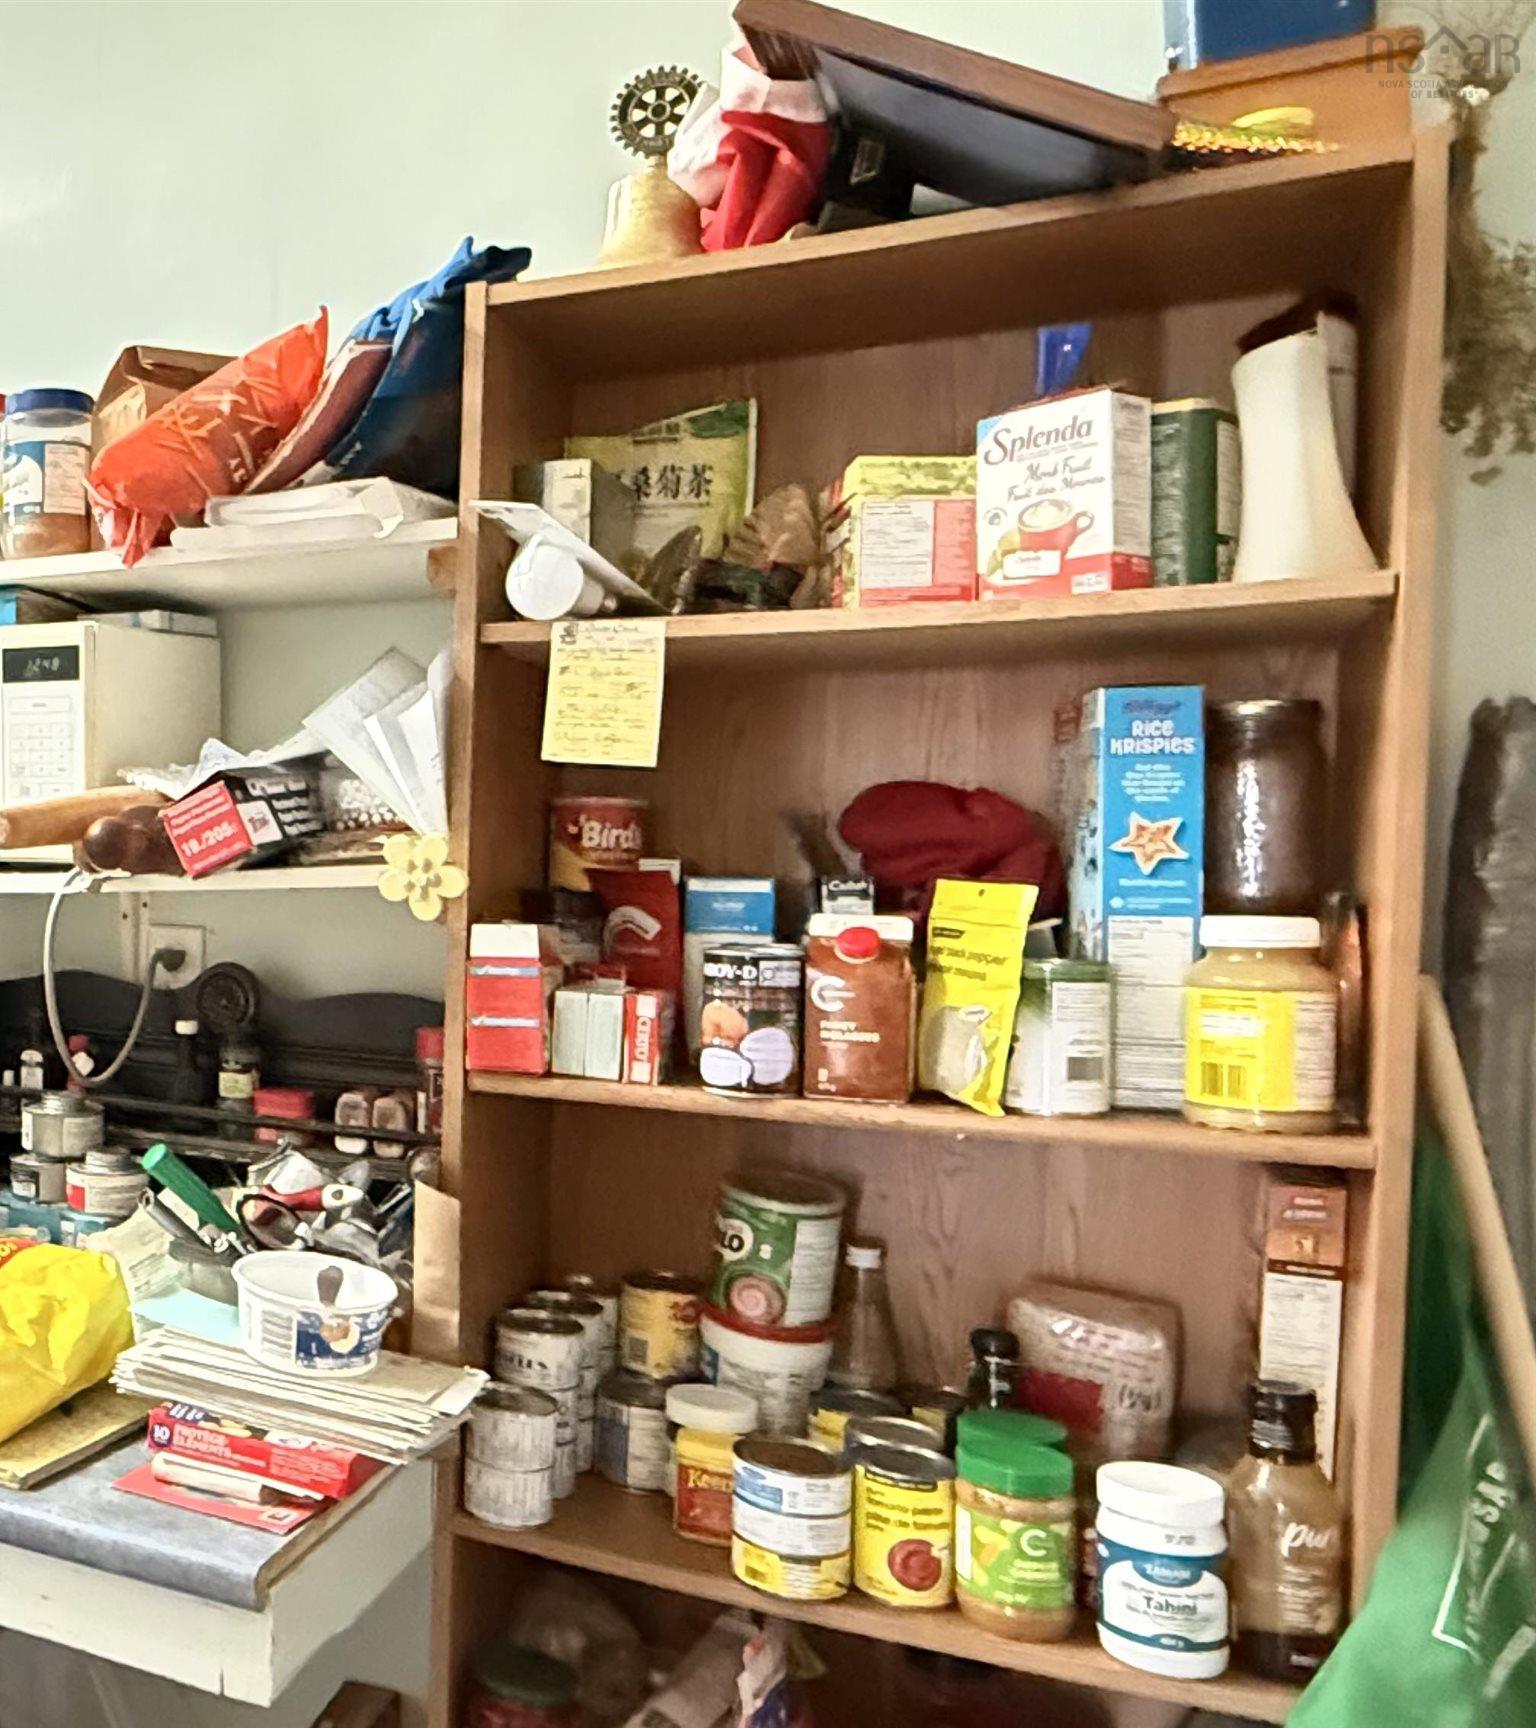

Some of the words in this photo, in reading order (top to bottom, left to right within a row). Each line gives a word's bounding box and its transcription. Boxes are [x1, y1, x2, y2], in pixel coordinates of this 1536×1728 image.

[983, 415, 1094, 466] Splenda
[614, 464, 713, 500] 桑菊茶
[1143, 1595, 1198, 1616] Tahini
